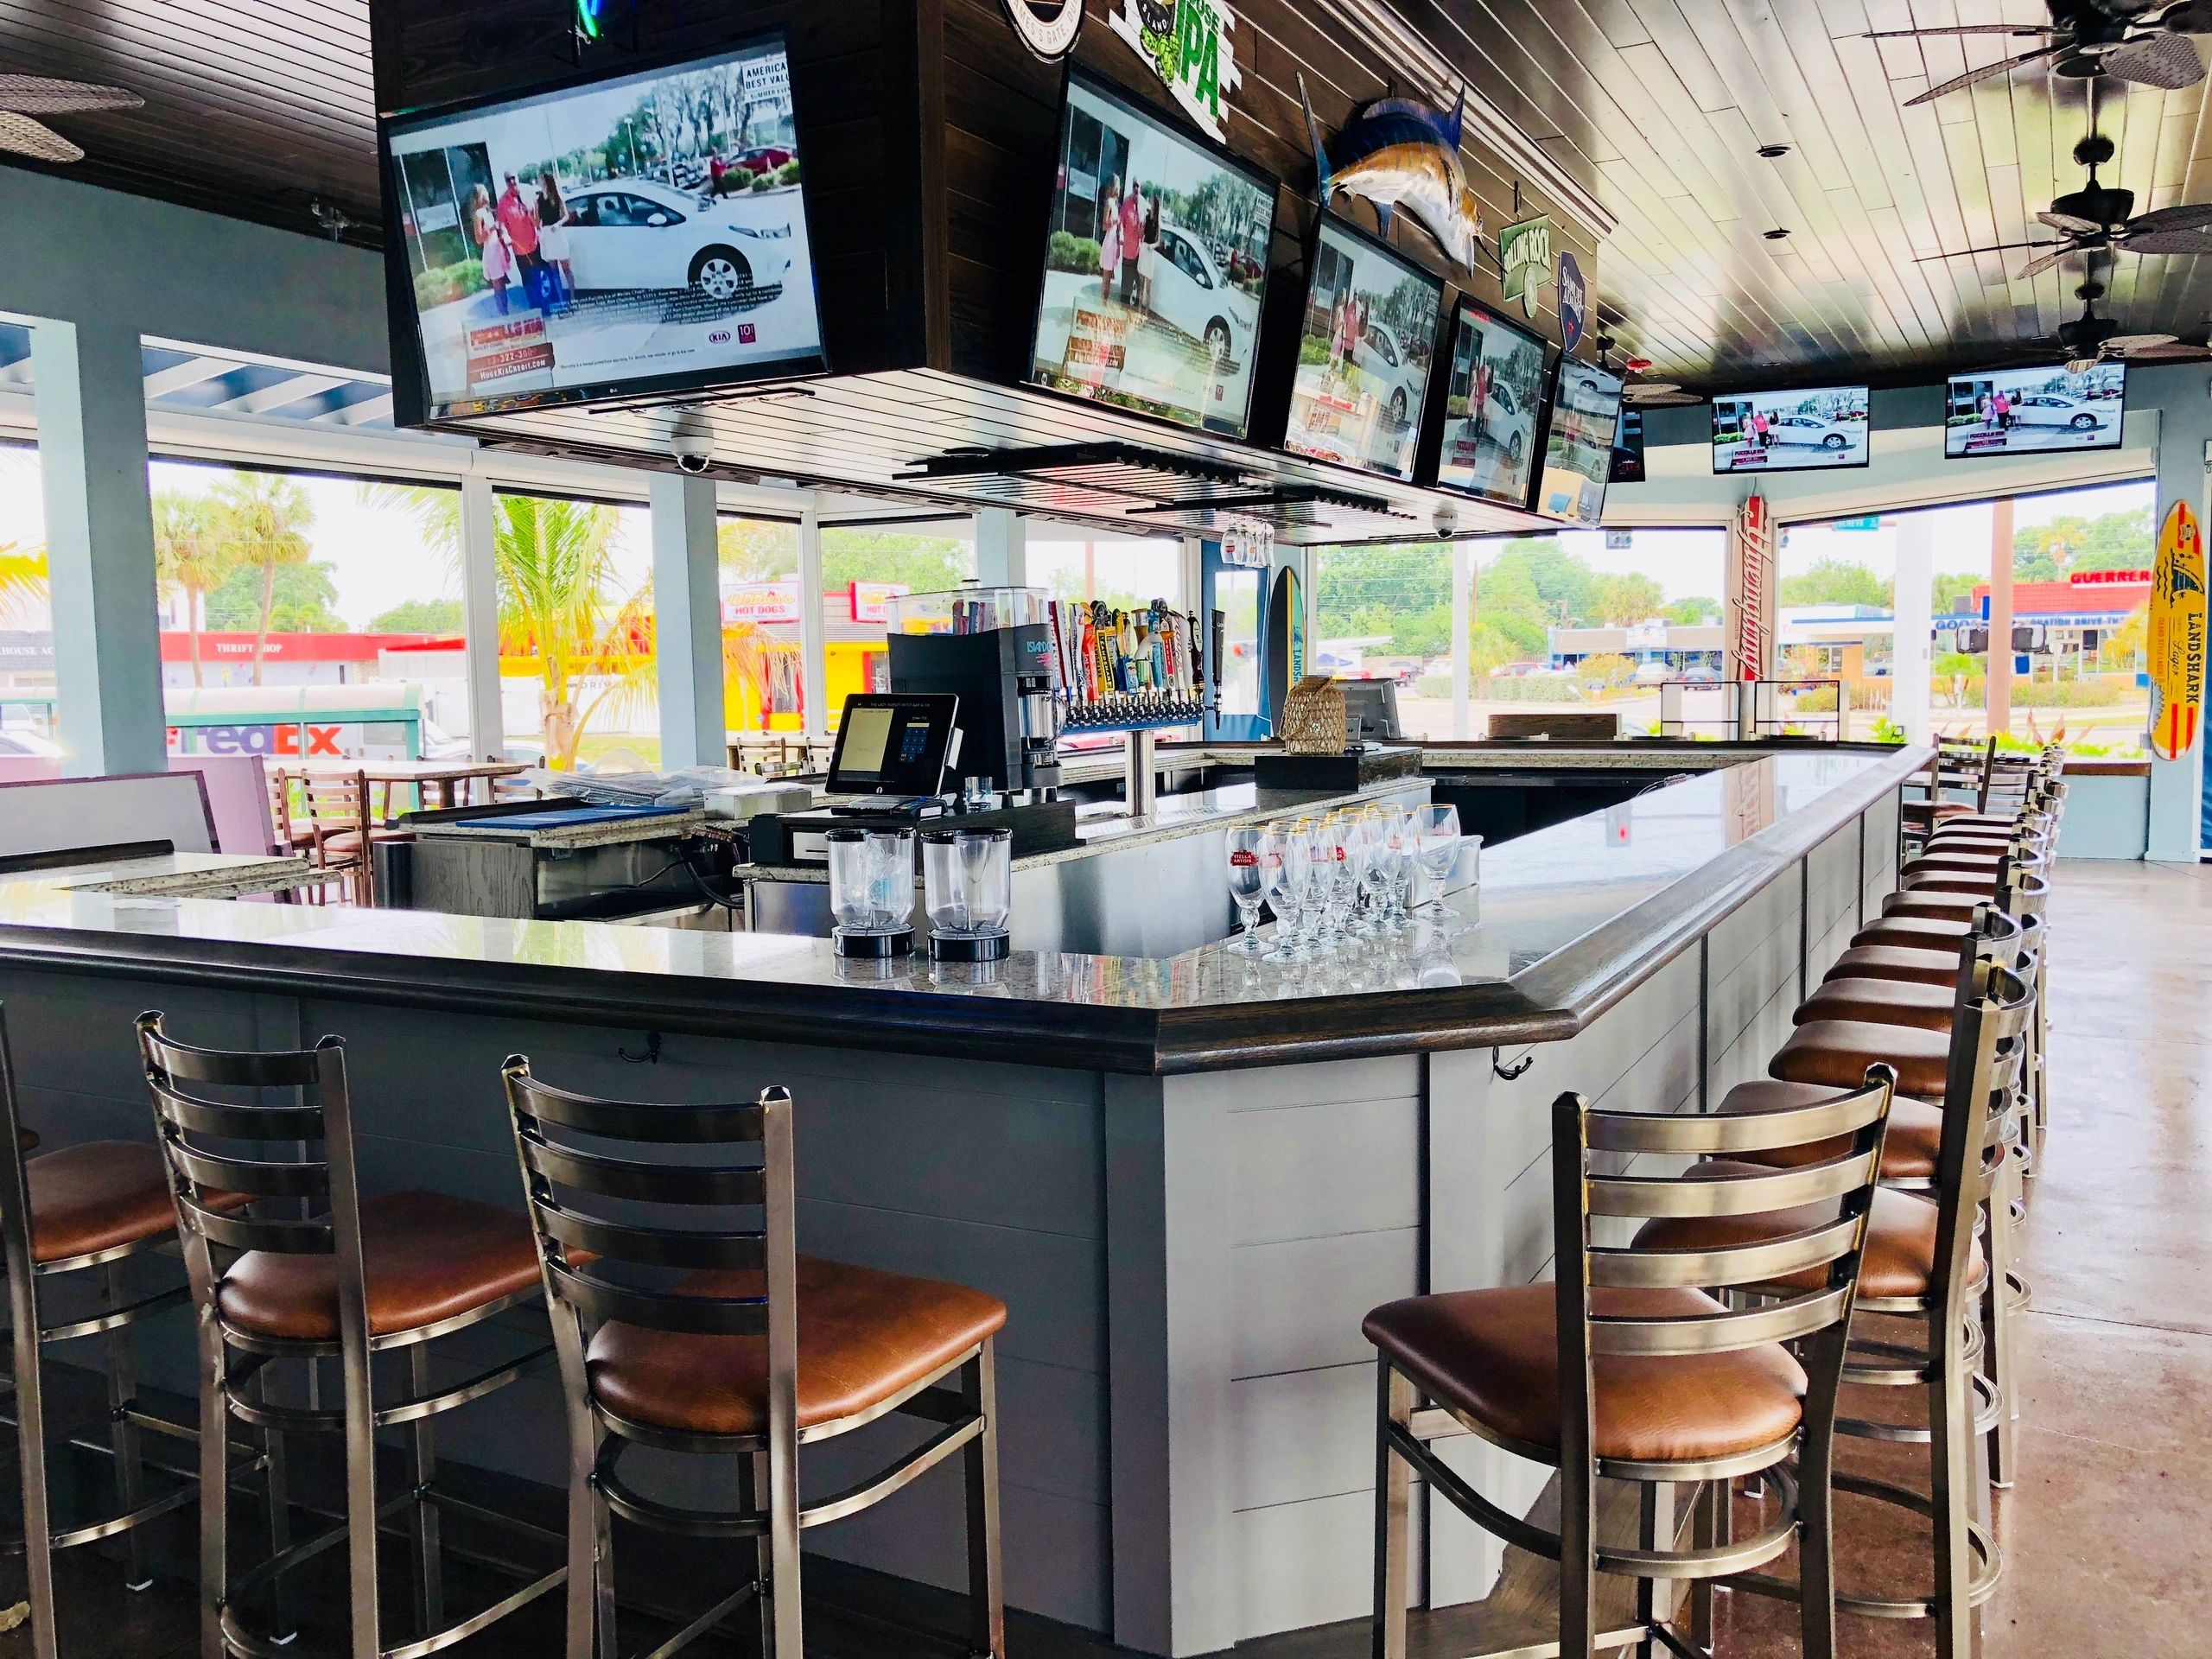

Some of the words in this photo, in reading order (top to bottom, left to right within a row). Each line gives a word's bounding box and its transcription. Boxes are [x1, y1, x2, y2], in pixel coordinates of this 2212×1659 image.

[1176, 0, 1219, 119] IPA
[745, 77, 766, 90] BEST
[1528, 226, 1552, 272] ROCK
[709, 331, 730, 344] KIA
[734, 607, 755, 615] HOT
[759, 605, 785, 614] DOGS
[215, 643, 254, 653] THRIFT
[2168, 639, 2186, 677] Lager
[2186, 613, 2202, 703] LANDSHARK
